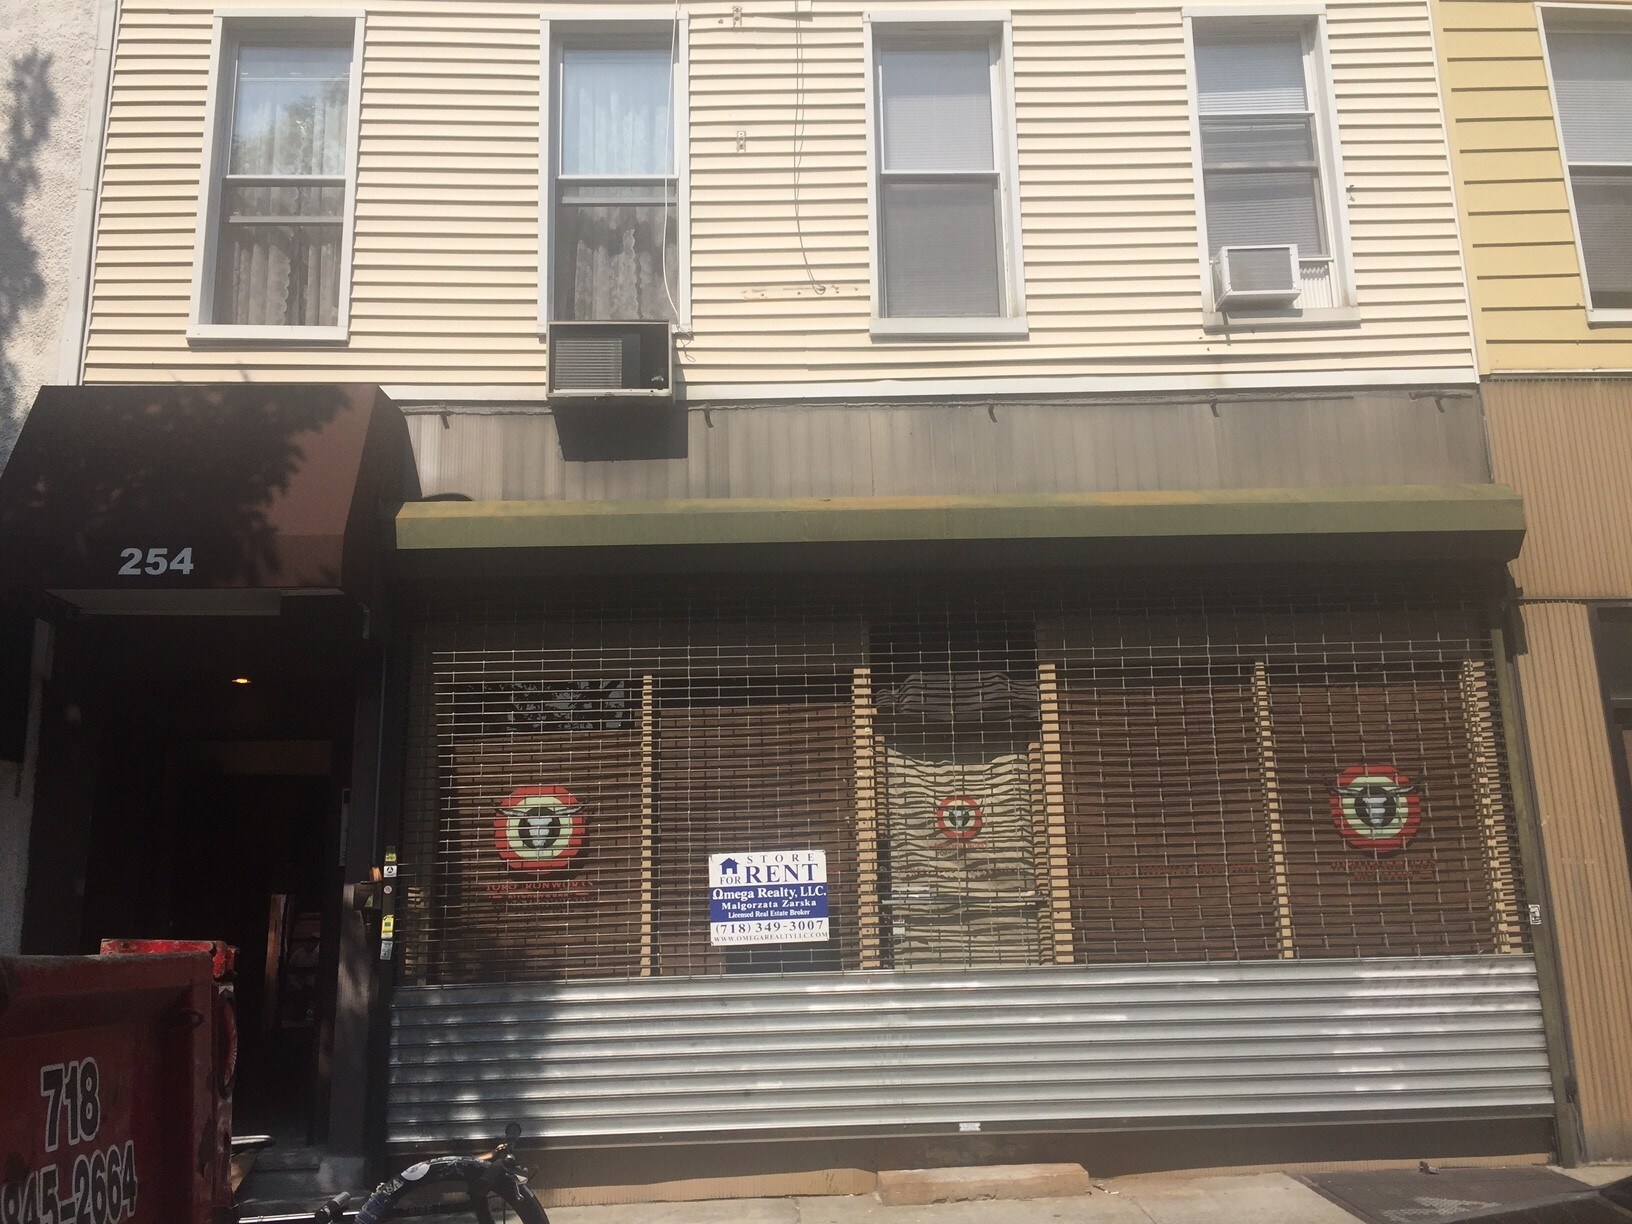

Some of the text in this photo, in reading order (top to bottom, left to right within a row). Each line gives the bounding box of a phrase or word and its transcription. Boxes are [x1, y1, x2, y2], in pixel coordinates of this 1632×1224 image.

[118, 547, 194, 575] 254
[746, 853, 815, 864] STORE
[720, 876, 741, 885] FOR
[745, 863, 819, 884] RENT
[757, 886, 798, 899] Realty,
[800, 885, 827, 897] LLC.
[721, 899, 817, 911] Malgorzata Zarska
[728, 908, 811, 919] Licensed Real Estate Broker
[715, 920, 823, 934] (718) 349-3007
[41, 1057, 100, 1152] 718
